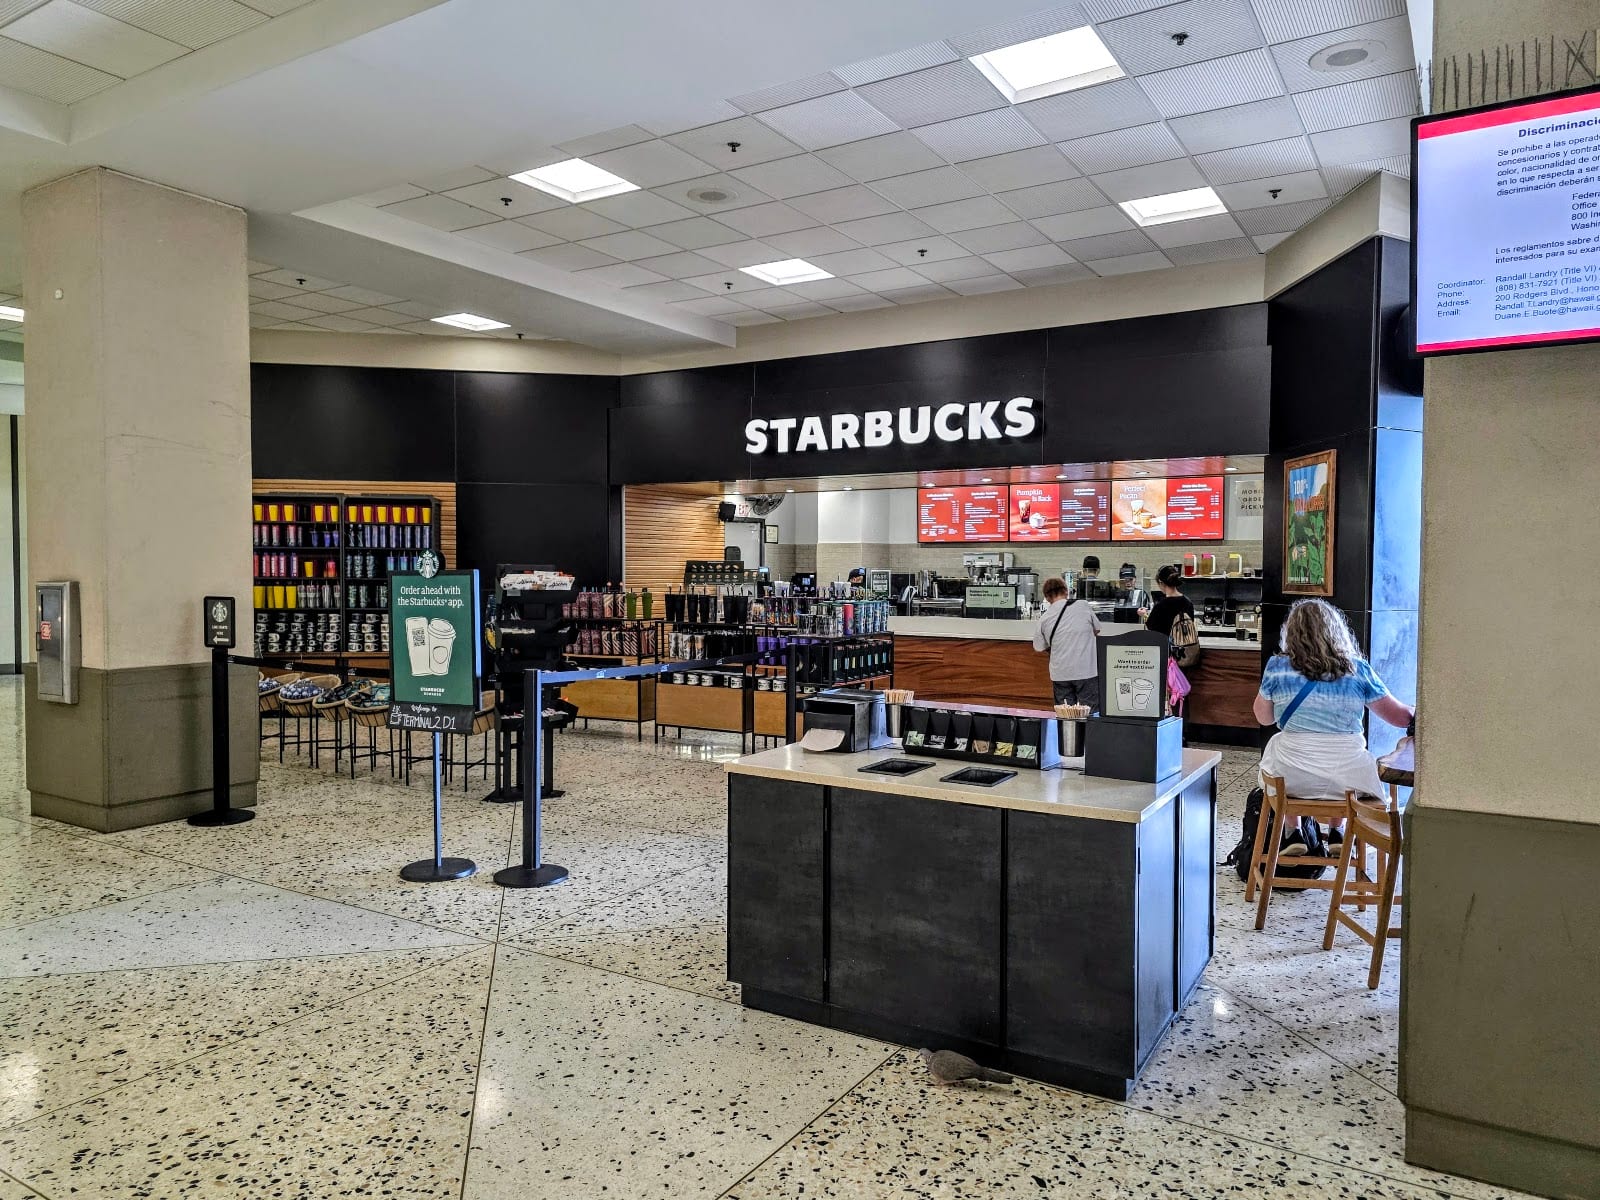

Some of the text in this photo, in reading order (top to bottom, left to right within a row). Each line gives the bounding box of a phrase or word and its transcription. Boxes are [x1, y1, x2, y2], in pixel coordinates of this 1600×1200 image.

[1497, 149, 1509, 157] Se
[1553, 140, 1566, 148] las
[1497, 151, 1561, 167] concesionarios
[1562, 149, 1569, 158] y
[1521, 158, 1576, 173] nacionalidad
[1578, 155, 1589, 164] de
[1509, 177, 1518, 185] lo
[1519, 175, 1536, 184] que
[1537, 168, 1575, 180] respecta
[1496, 181, 1557, 197] discriminación
[1558, 175, 1595, 187] deberán
[1571, 201, 1598, 211] Office
[1571, 211, 1588, 221] 800
[1495, 247, 1511, 255] Los
[1513, 241, 1565, 253] reglamentos
[1495, 252, 1543, 264] interesados
[1545, 250, 1565, 260] para
[1495, 272, 1527, 283] Randall
[1529, 269, 1558, 280] Landry
[1560, 266, 1581, 277] (Title
[1583, 264, 1597, 274] VI)
[1495, 293, 1511, 302] 200
[1513, 290, 1548, 300] Rodgers
[745, 396, 1036, 454] STARBUCKS
[400, 585, 461, 595] Order ahead with
[397, 596, 409, 606] the
[447, 599, 465, 609] app.
